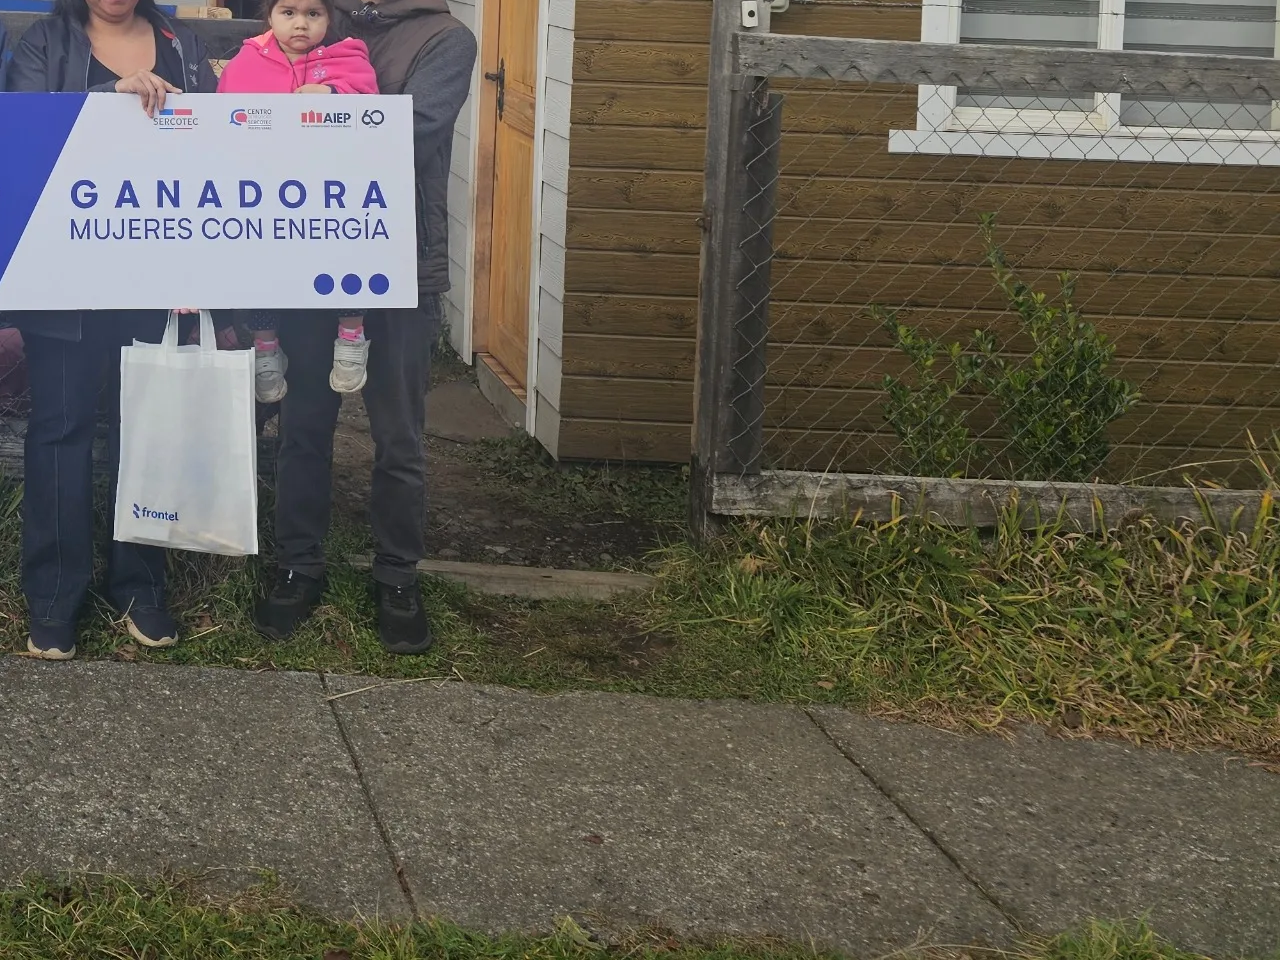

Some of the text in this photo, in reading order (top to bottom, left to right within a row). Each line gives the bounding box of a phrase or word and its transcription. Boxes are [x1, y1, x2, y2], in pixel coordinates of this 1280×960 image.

[153, 117, 199, 126] SERCOTEC
[323, 109, 385, 126] AIEP 60
[70, 179, 388, 209] GANADORA
[70, 212, 390, 240] MUJERES CON ENERGÍA
[141, 506, 179, 521] frontel
